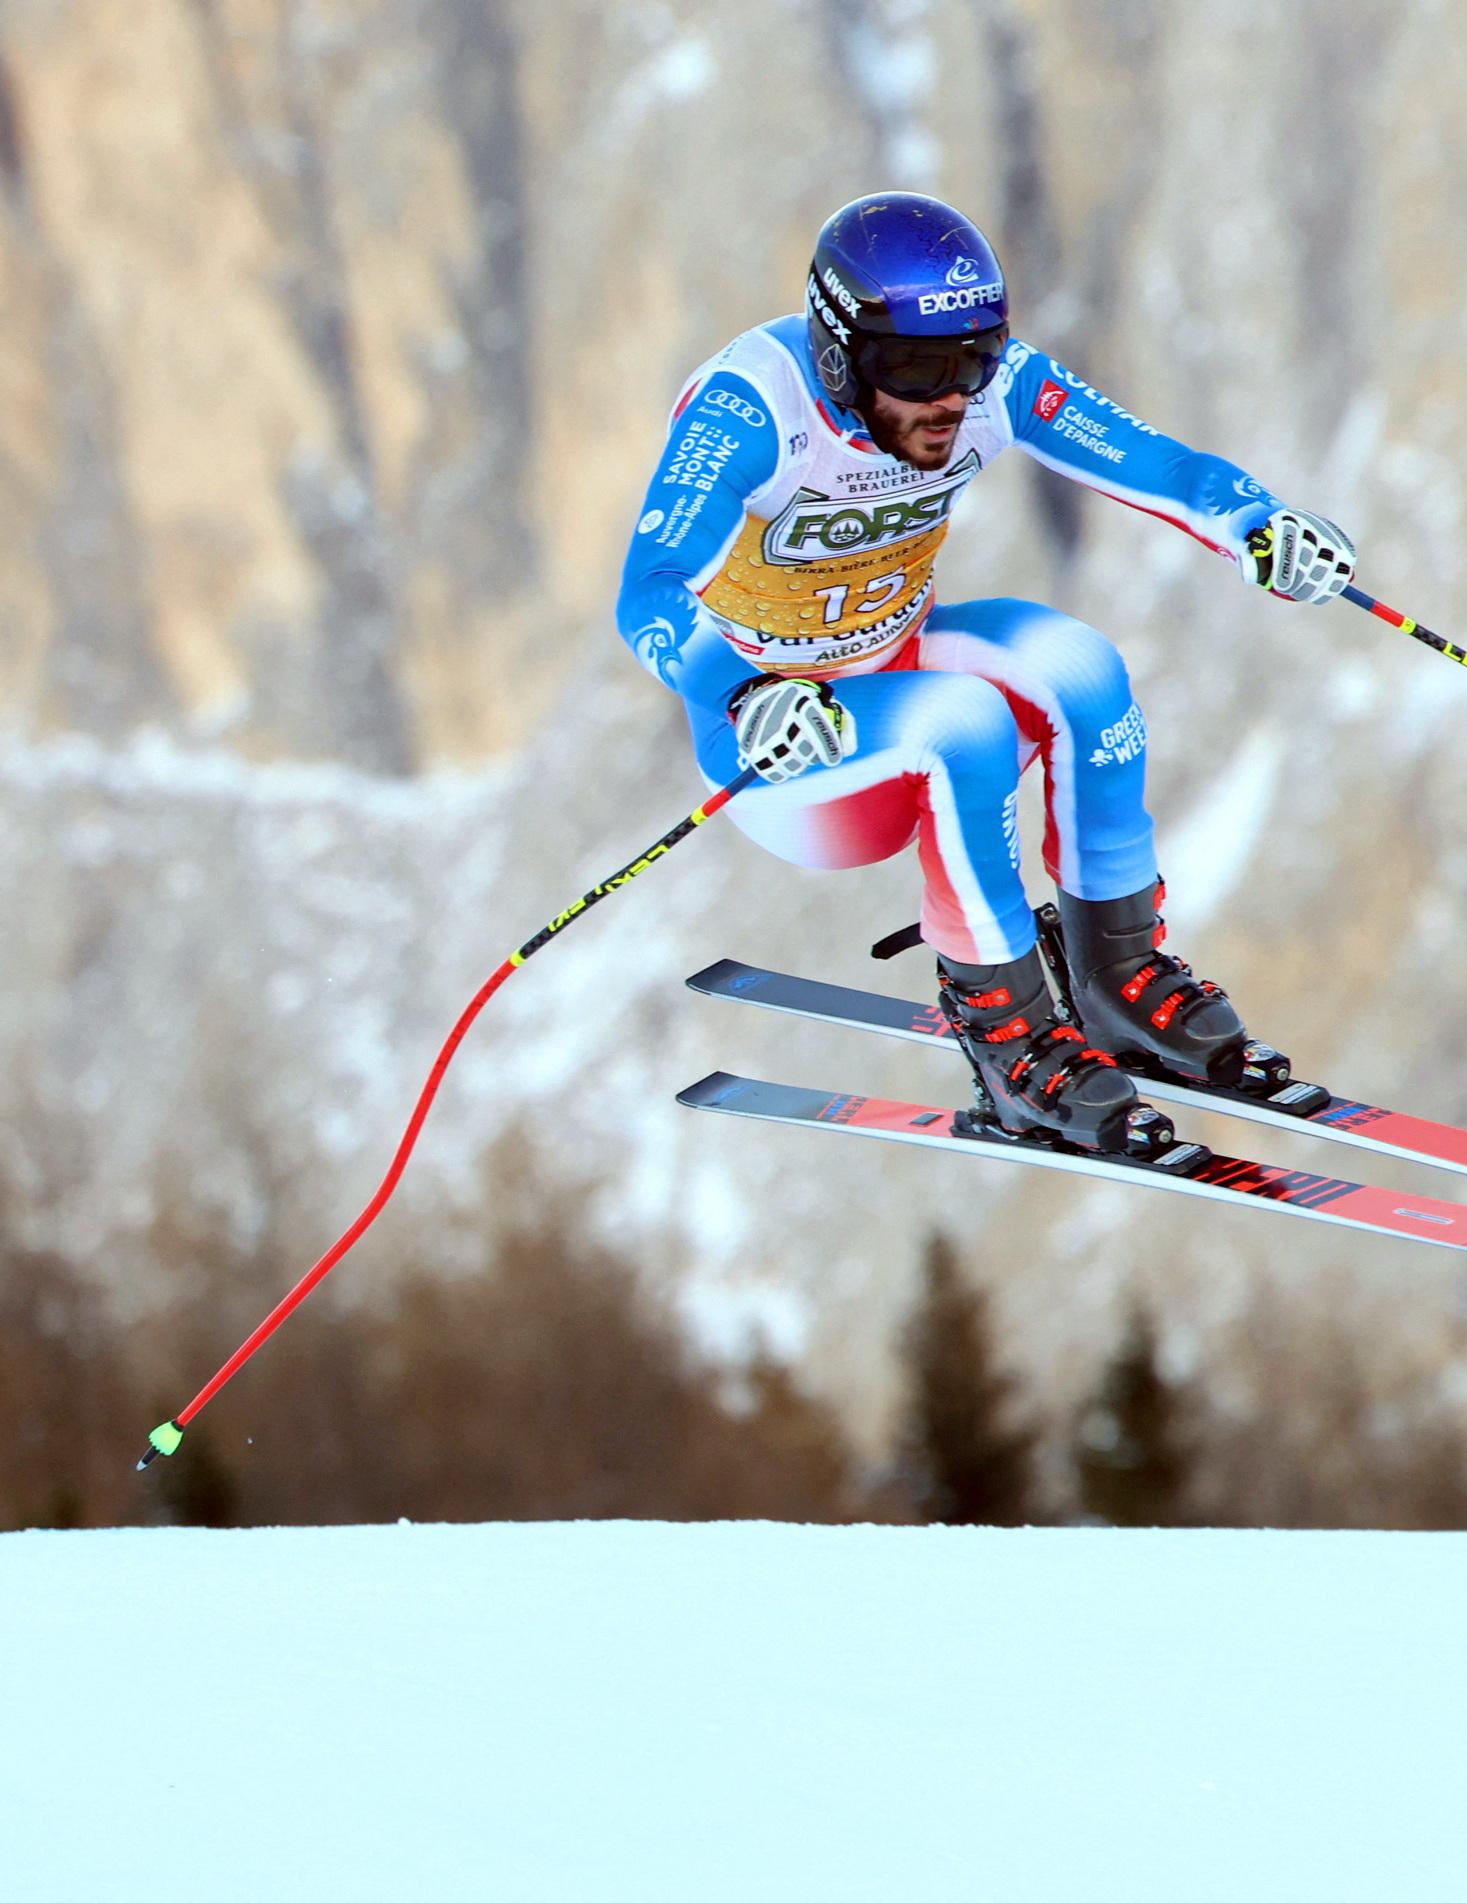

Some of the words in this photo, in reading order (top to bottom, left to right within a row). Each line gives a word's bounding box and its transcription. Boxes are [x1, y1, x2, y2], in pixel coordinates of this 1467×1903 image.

[808, 273, 852, 346] uvex
[824, 267, 862, 319] uvex
[918, 282, 1004, 316] EXCOFFIER
[697, 405, 724, 418] Audi
[1063, 405, 1110, 438] CAISSE
[662, 420, 708, 485] SAVOIE
[677, 437, 716, 487] MONT
[694, 434, 740, 493] BLANC
[1052, 418, 1128, 464] D'EPARGNE
[847, 472, 926, 494] BRAUEREI
[784, 489, 955, 550] FORST
[1281, 533, 1295, 580] reusch
[812, 566, 909, 625] 15
[812, 716, 840, 756] reusch
[1113, 727, 1146, 764] WEE
[595, 844, 671, 895] LEKI
